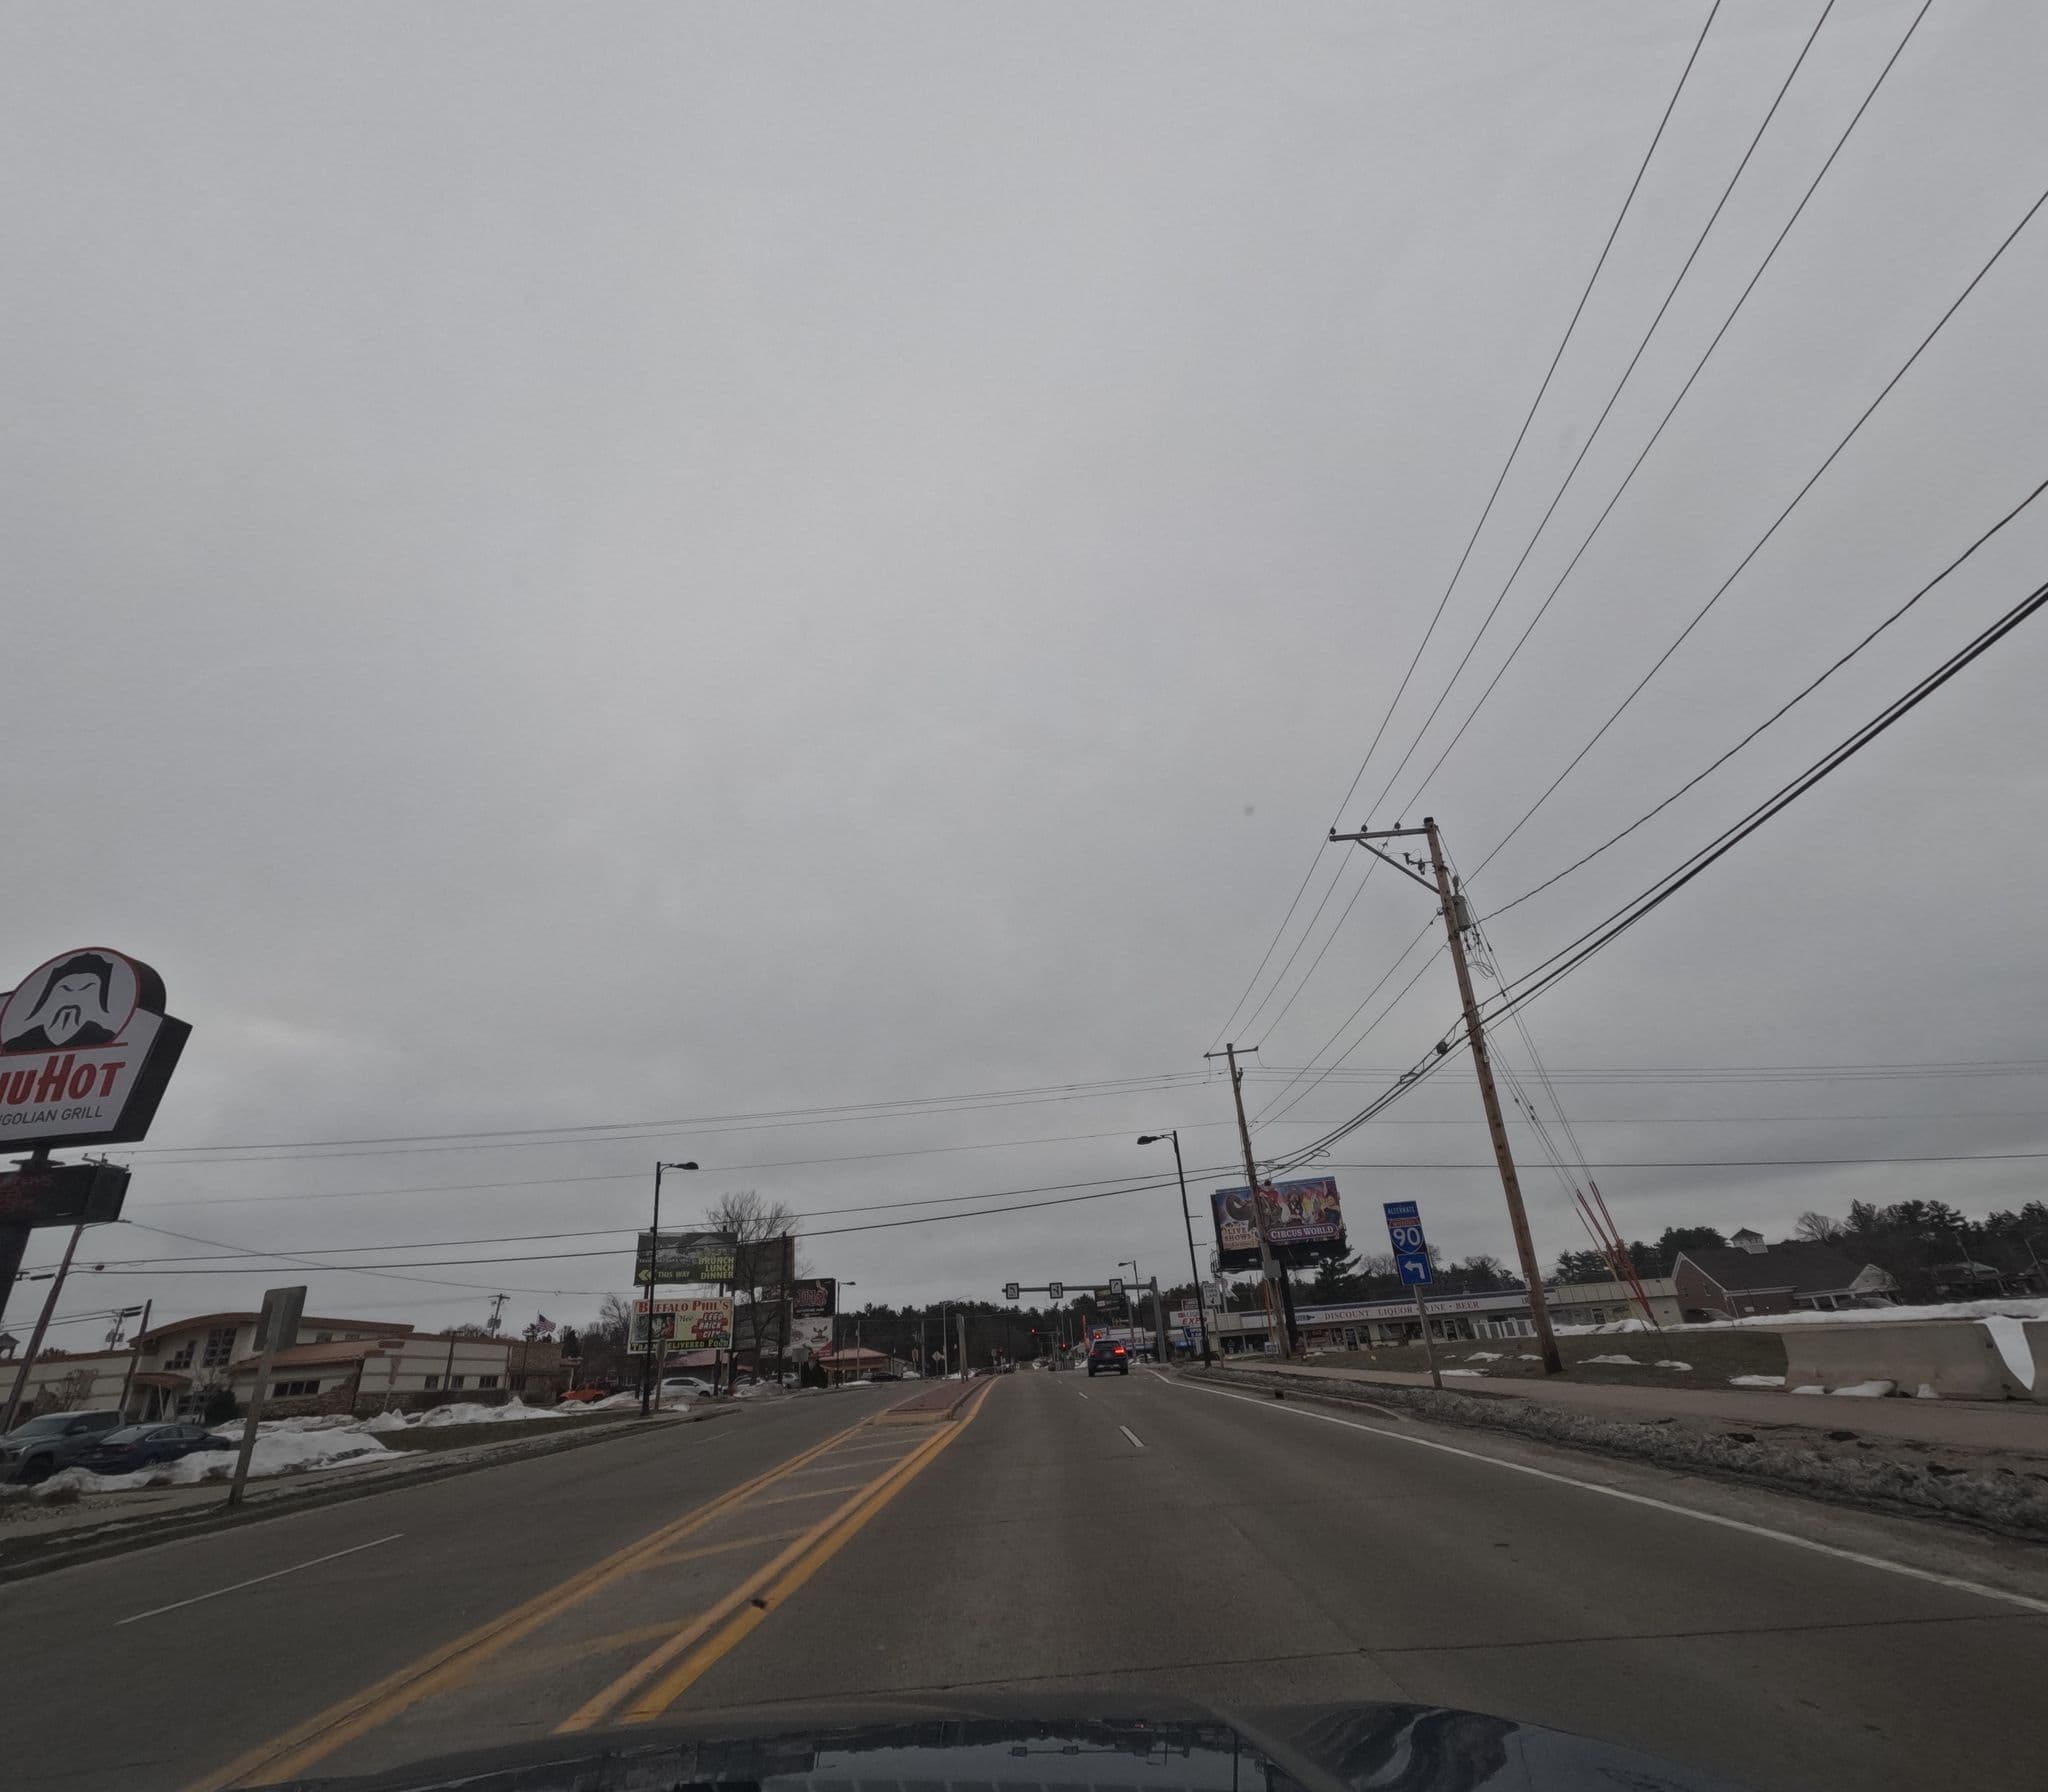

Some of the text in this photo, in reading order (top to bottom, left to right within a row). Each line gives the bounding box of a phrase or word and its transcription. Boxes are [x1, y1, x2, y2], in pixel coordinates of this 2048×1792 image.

[0, 1054, 126, 1106] UHOT
[0, 1105, 104, 1126] GOLIAN GRILL
[1270, 1225, 1334, 1240] CIRCUS WORLD
[1393, 1228, 1421, 1247] 90
[698, 1256, 735, 1265] BRUNCH
[705, 1264, 735, 1272] LUNCH
[657, 1270, 690, 1280] THIS WAY
[700, 1271, 735, 1280] DINNER
[638, 1301, 689, 1313] BFFALO
[1324, 1309, 1370, 1321] DISCOUNT
[1378, 1305, 1413, 1316] LIQUOR
[1455, 1300, 1480, 1311] BEER
[698, 1321, 721, 1331] BRICK
[631, 1342, 657, 1352] TRAN
[667, 1340, 705, 1349] ELIVERED
